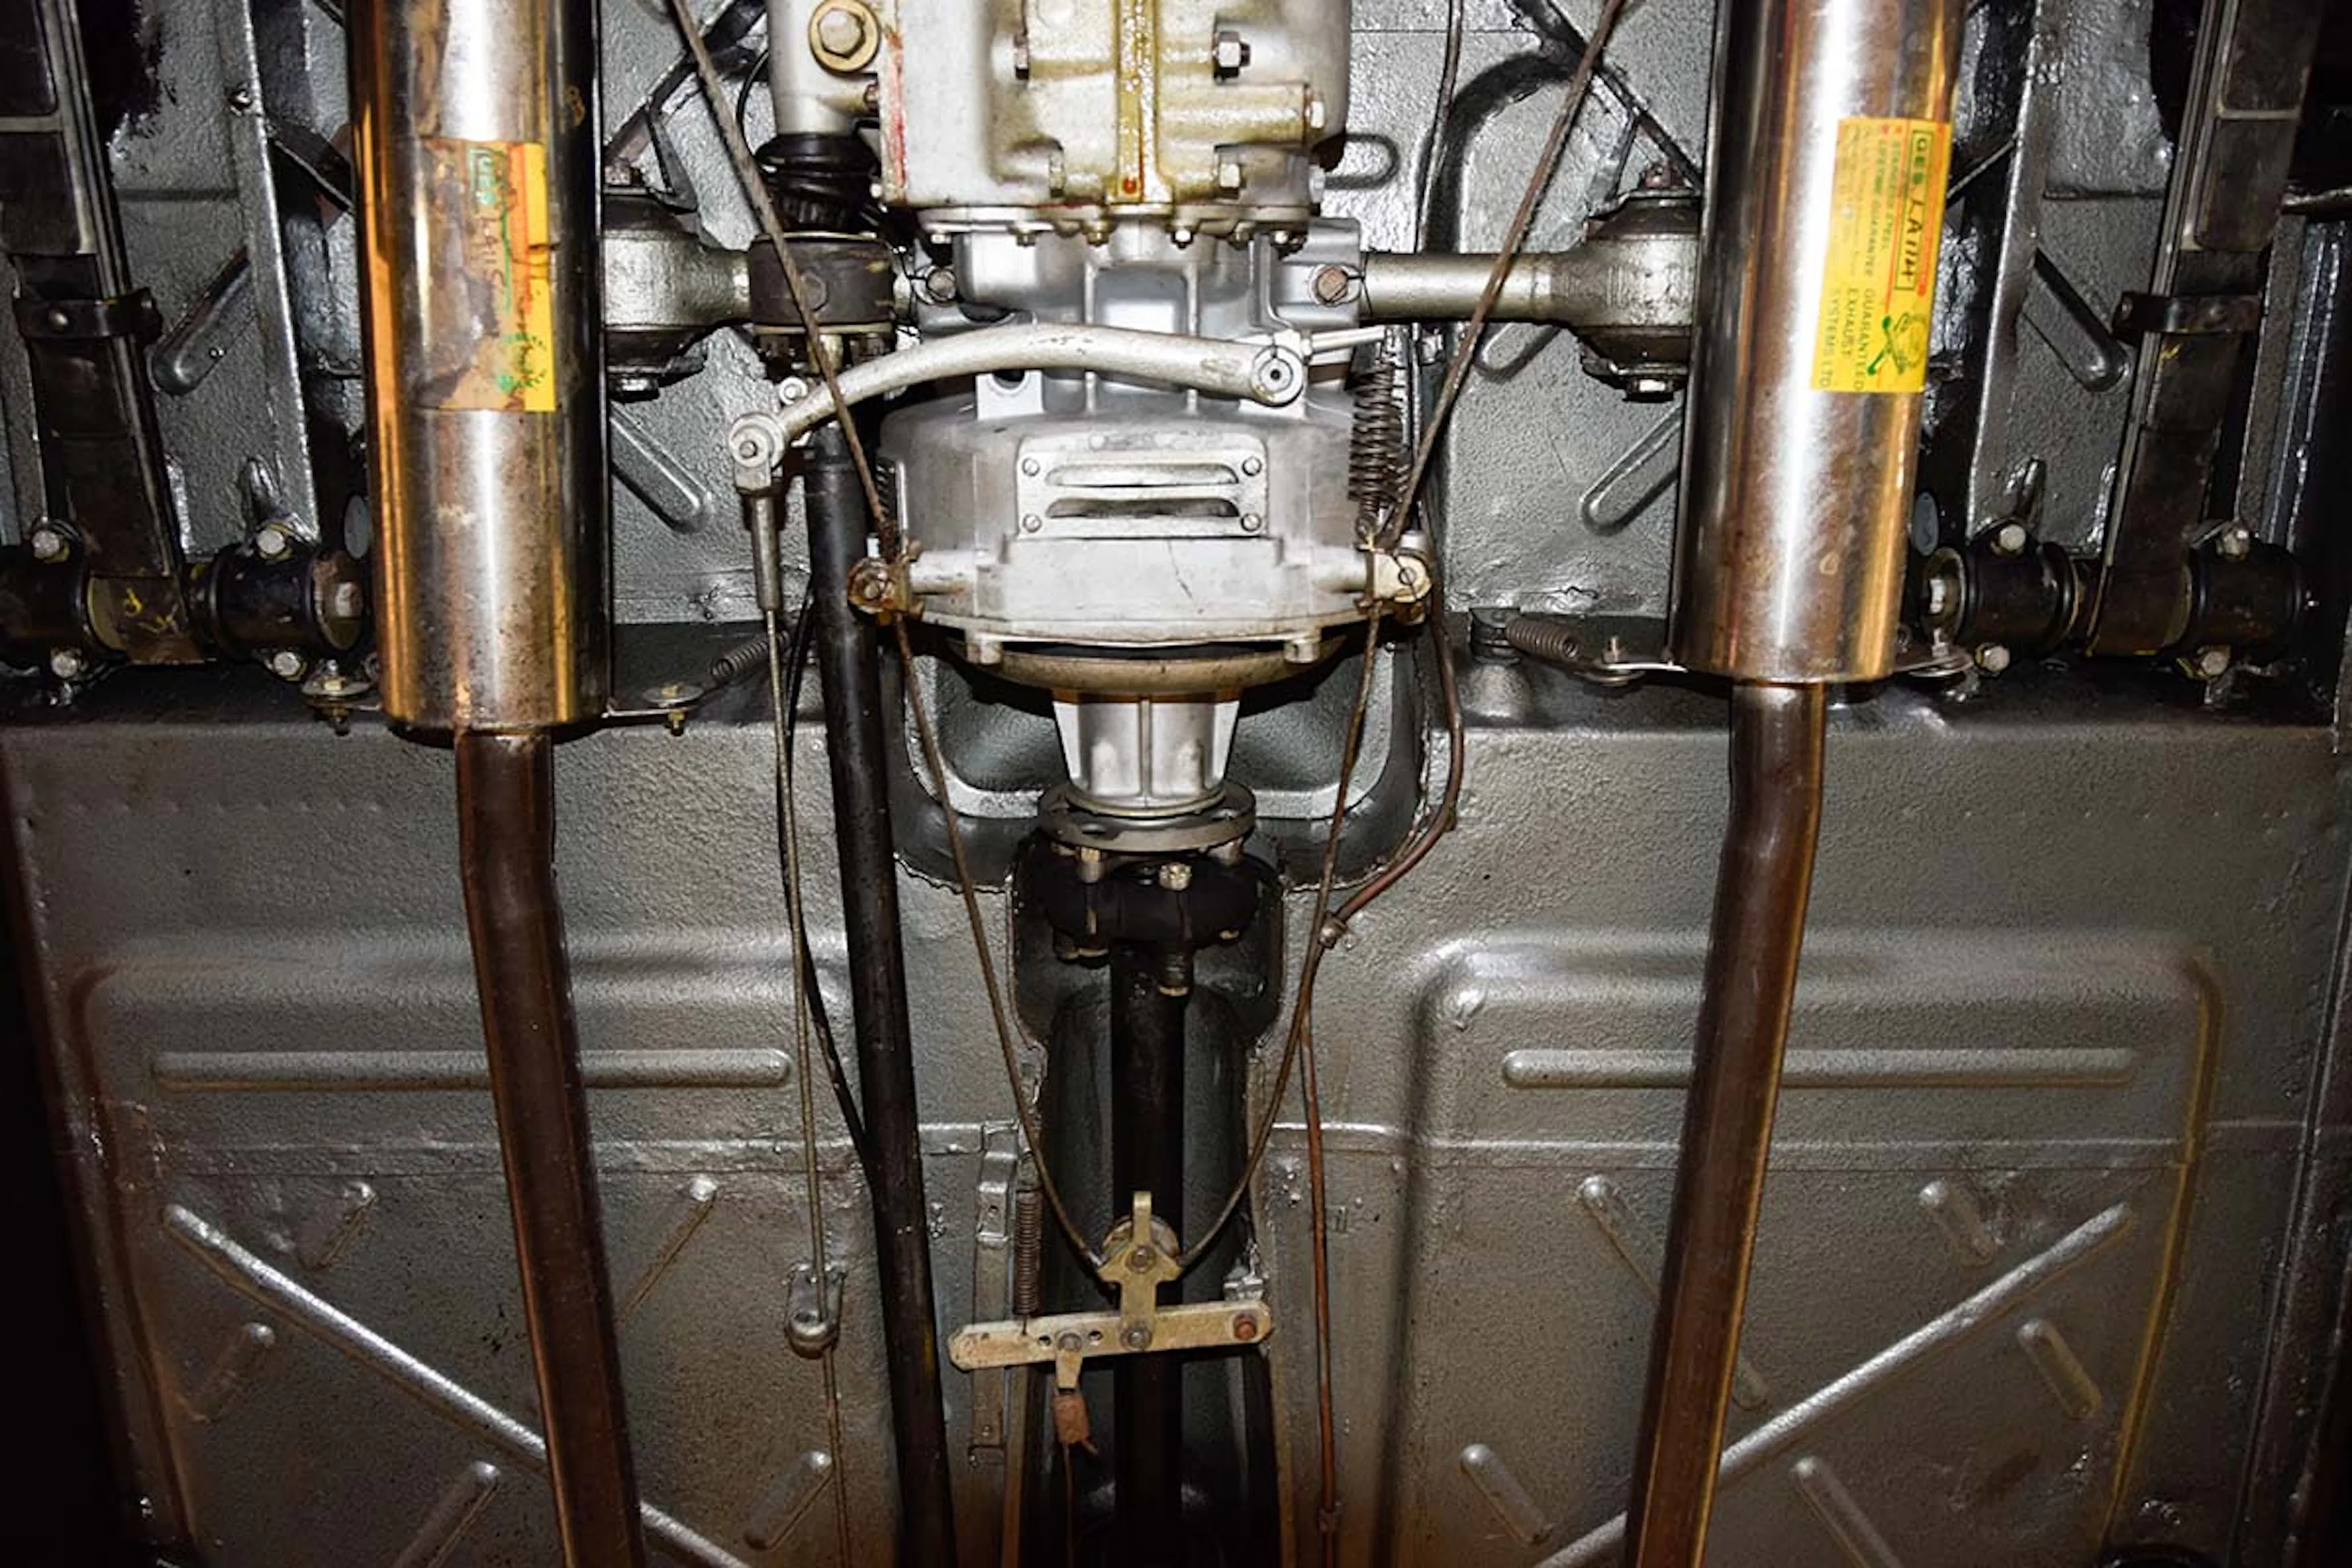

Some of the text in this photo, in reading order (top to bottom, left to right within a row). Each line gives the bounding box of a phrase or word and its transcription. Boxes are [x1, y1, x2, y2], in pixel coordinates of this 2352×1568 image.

[1841, 288, 1860, 356] EXHAUST
[1853, 288, 1877, 391] GUARANTEED
[1819, 361, 1834, 390] LTD
